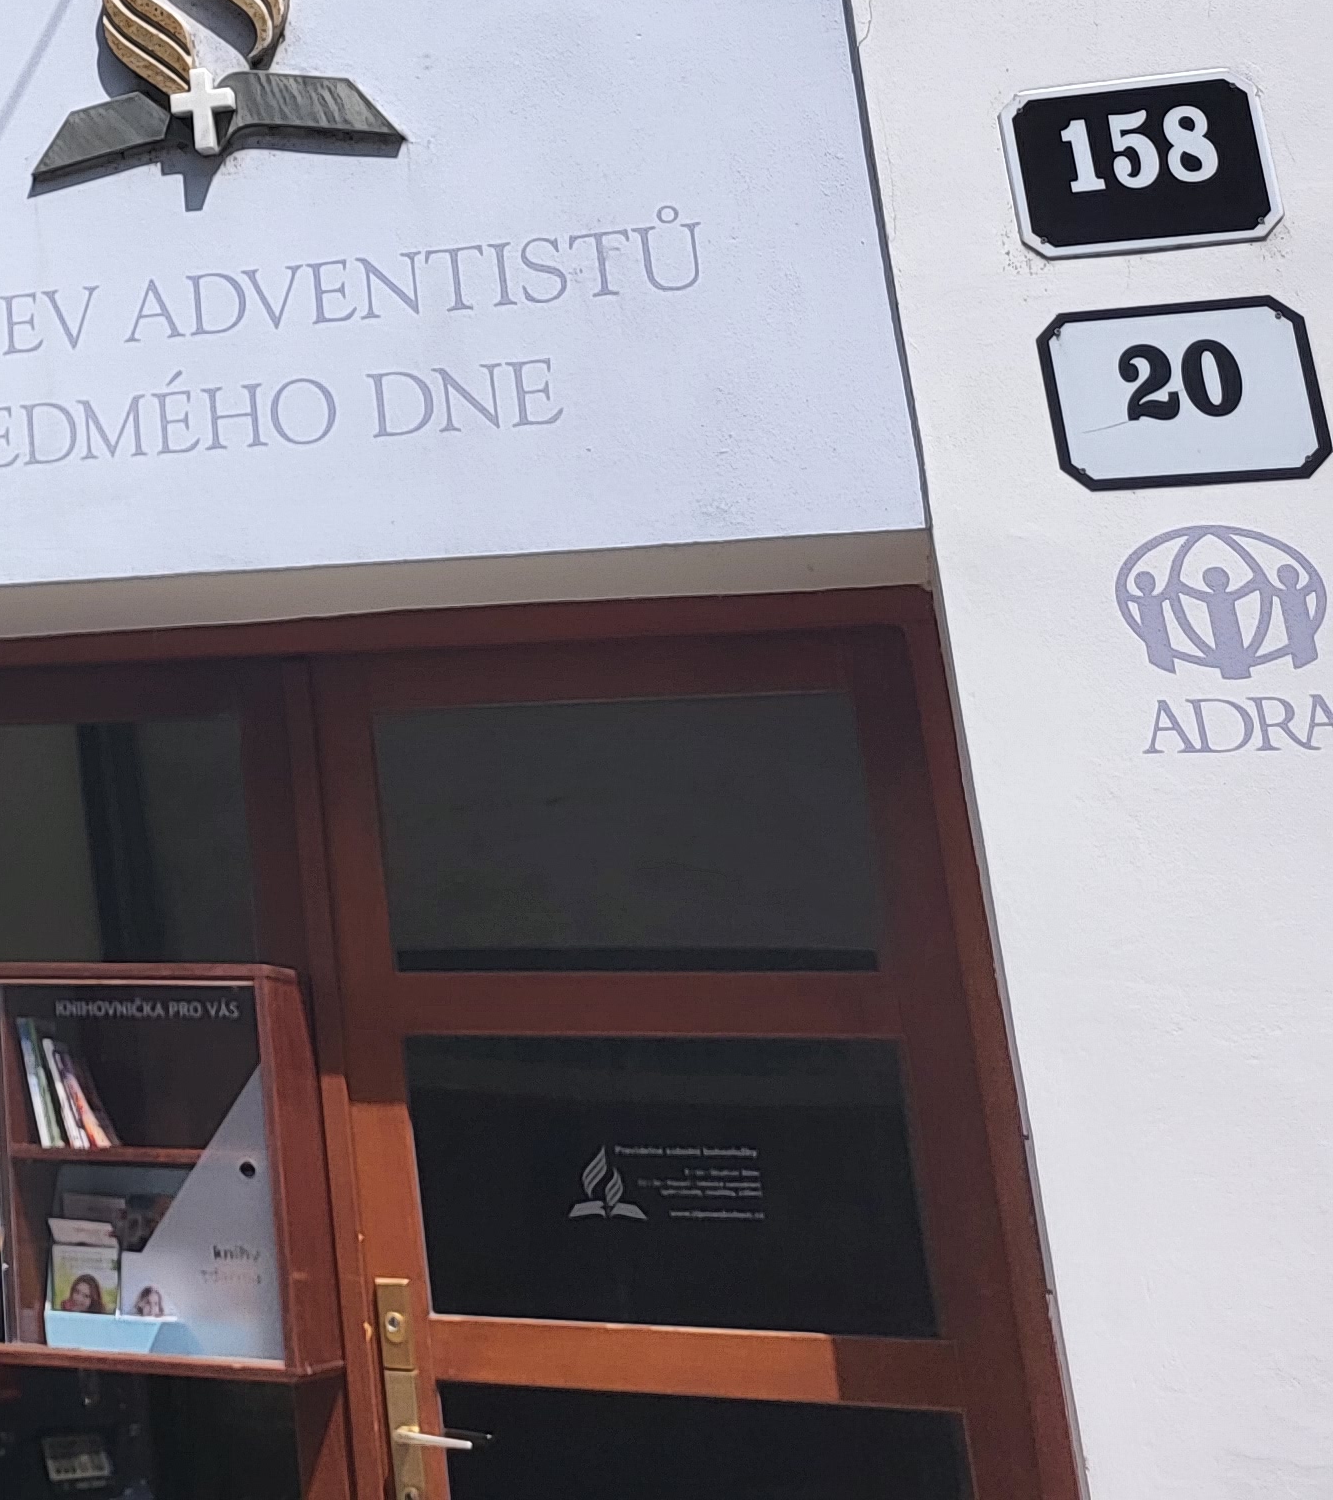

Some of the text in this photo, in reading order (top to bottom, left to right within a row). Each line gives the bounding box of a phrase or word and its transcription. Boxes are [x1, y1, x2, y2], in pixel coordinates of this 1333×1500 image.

[1060, 106, 1219, 194] 158
[125, 204, 705, 344] ADVENTISTŮ
[367, 357, 565, 440] DNE
[1118, 339, 1243, 422] 20
[1142, 693, 1333, 754] ADRA
[55, 997, 240, 1020] KNIHOVNIČKA PRO VÁS
